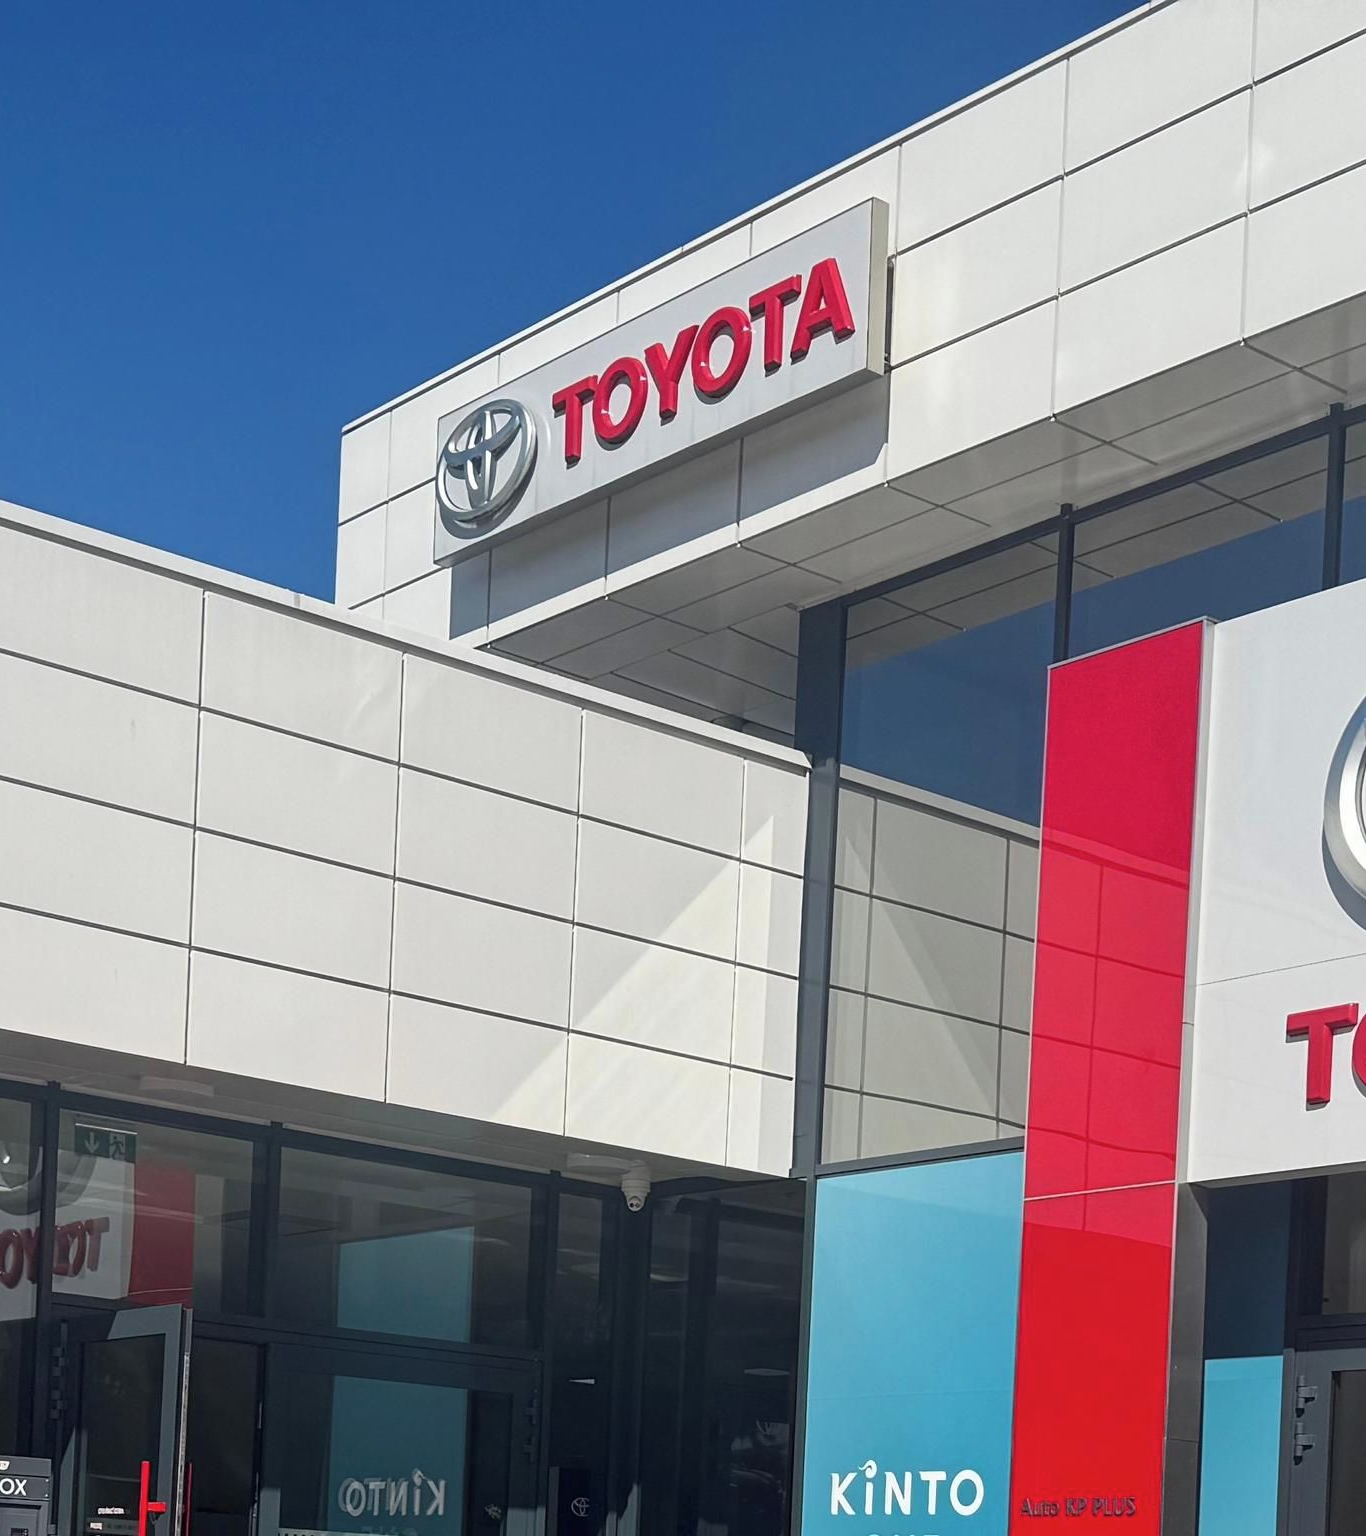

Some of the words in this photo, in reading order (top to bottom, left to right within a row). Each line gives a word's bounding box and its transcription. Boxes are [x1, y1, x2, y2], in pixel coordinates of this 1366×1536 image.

[552, 258, 856, 468] TOYOTA
[1021, 1498, 1060, 1516] Auto
[1066, 1497, 1087, 1516] KP
[1093, 1497, 1136, 1516] PLUS
